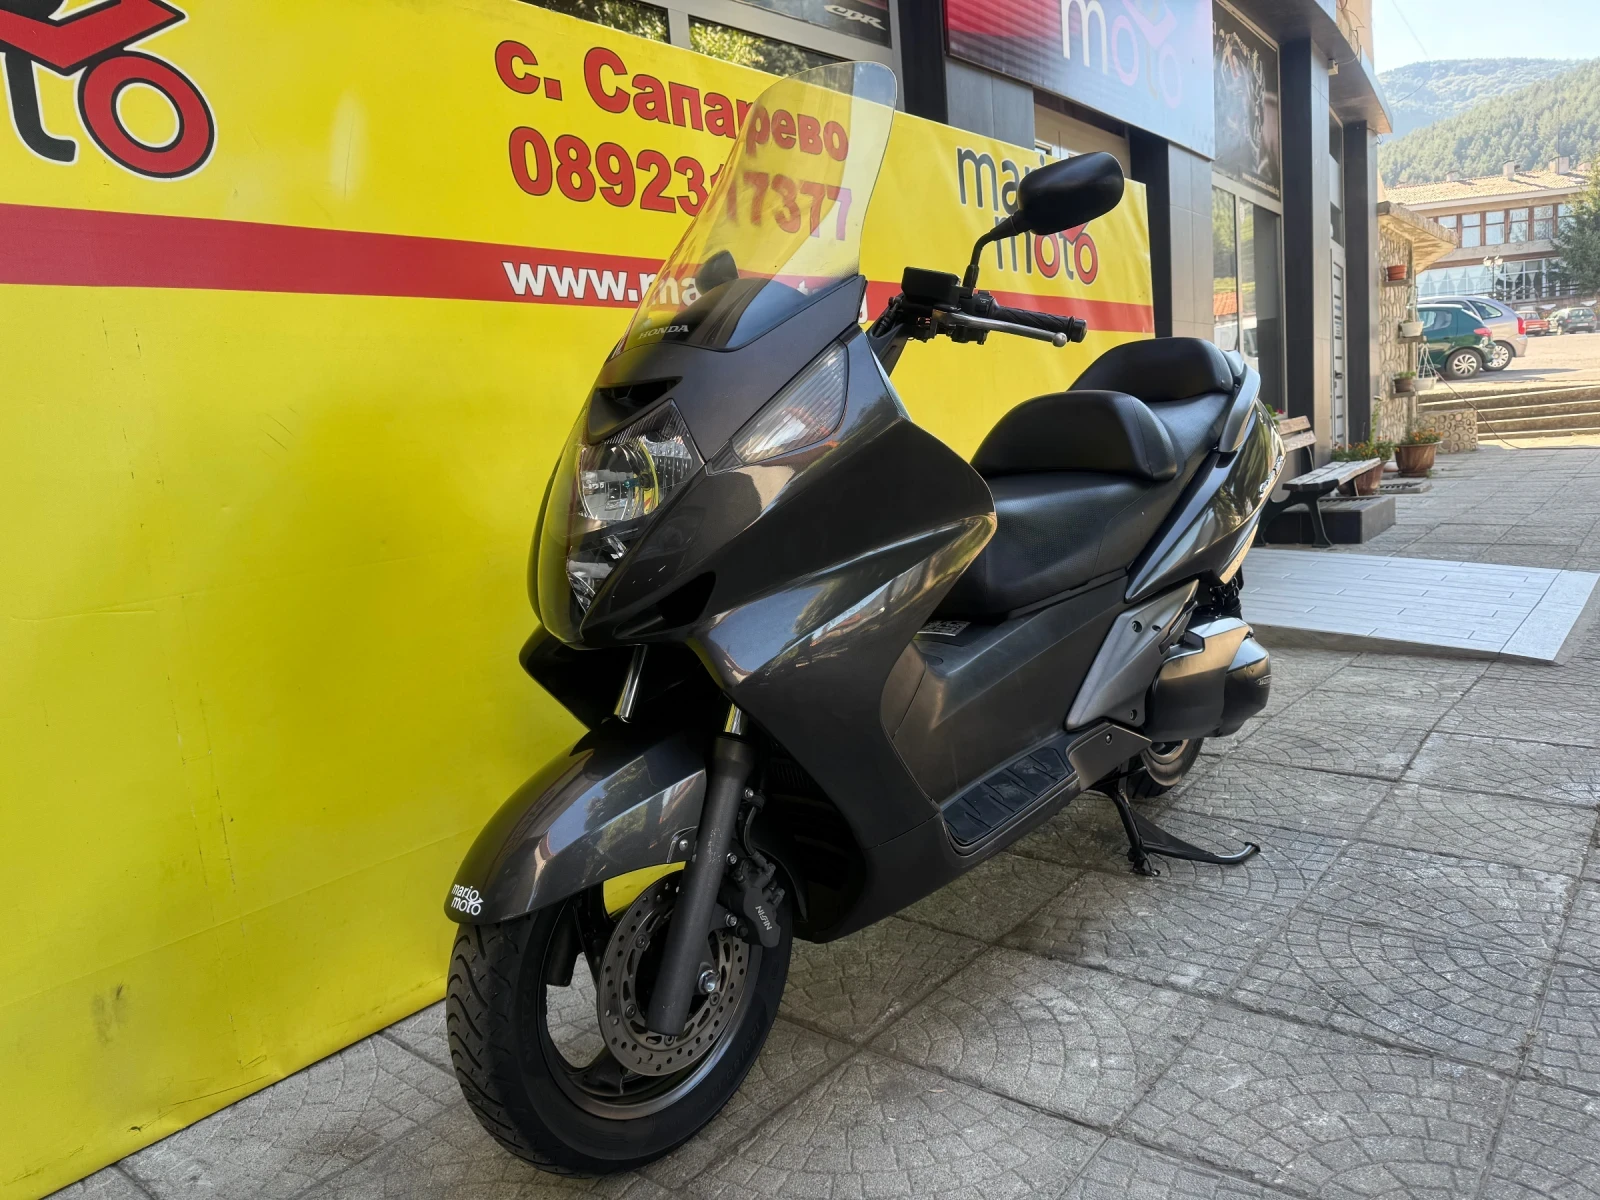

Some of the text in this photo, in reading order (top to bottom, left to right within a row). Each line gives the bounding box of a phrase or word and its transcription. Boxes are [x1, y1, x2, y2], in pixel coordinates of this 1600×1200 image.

[583, 46, 850, 162] Сапарево
[637, 324, 690, 340] HONDA
[451, 884, 479, 901] mario
[450, 896, 482, 916] moto
[755, 905, 773, 931] NISSIN
